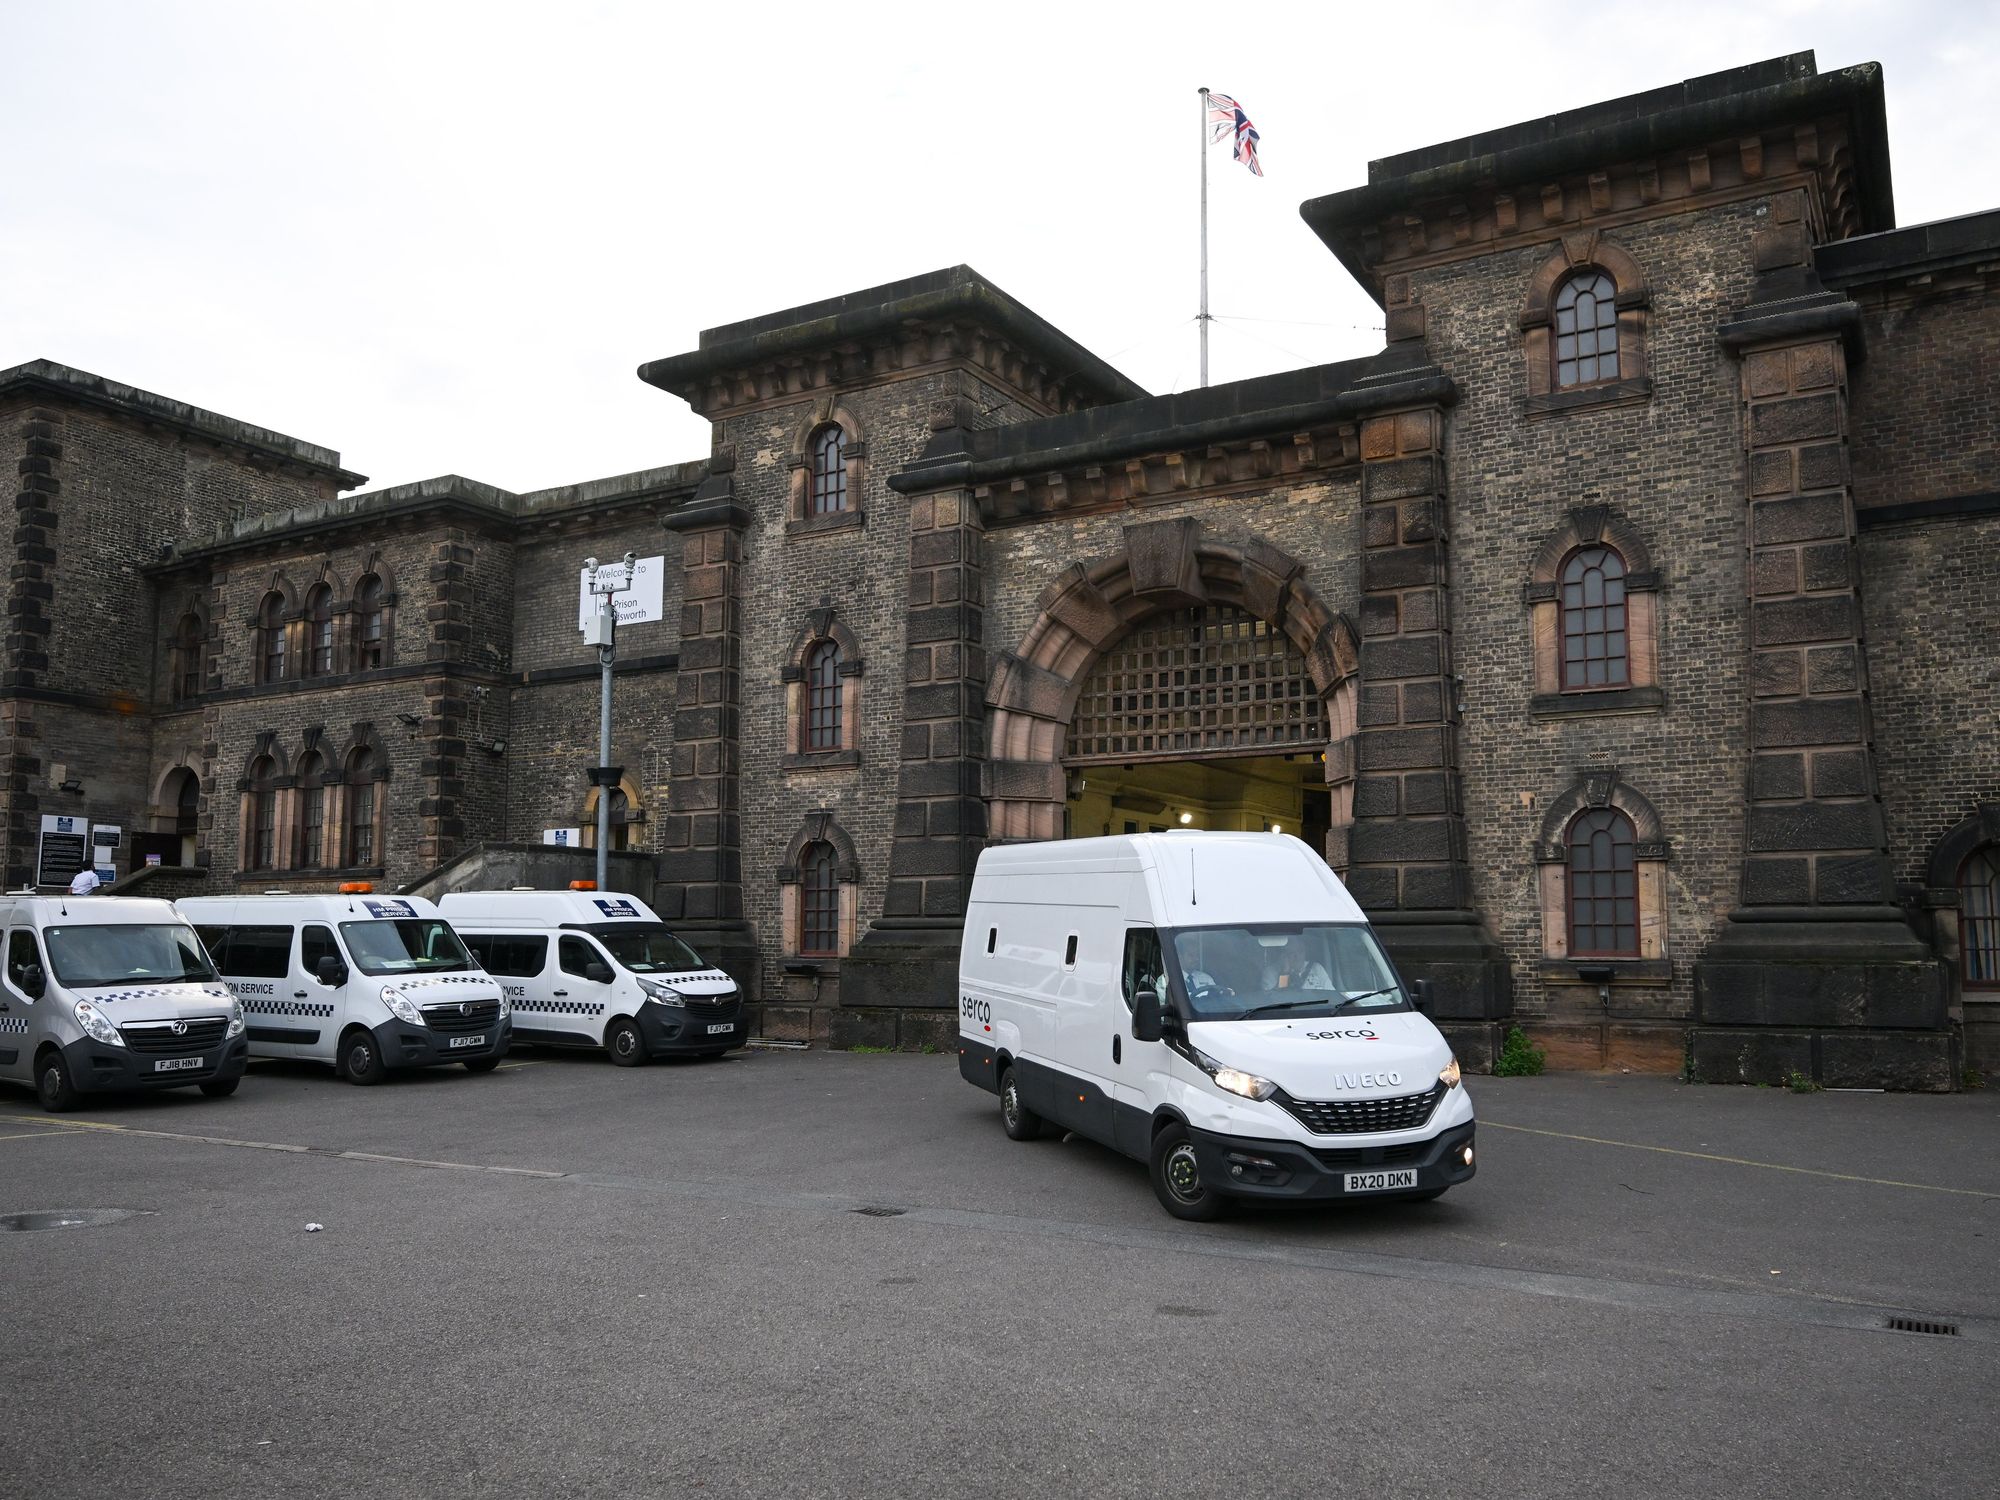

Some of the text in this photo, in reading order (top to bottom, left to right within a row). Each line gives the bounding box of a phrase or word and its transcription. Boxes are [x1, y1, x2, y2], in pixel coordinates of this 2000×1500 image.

[638, 565, 647, 574] to
[614, 599, 638, 609] Prison
[240, 983, 274, 995] SERVICE
[962, 995, 991, 1024] serco
[1306, 1029, 1376, 1041] serco
[160, 1058, 199, 1070] FJ18 HNV
[1334, 1071, 1402, 1090] IVECO
[1350, 1172, 1412, 1190] BX20 DKN
